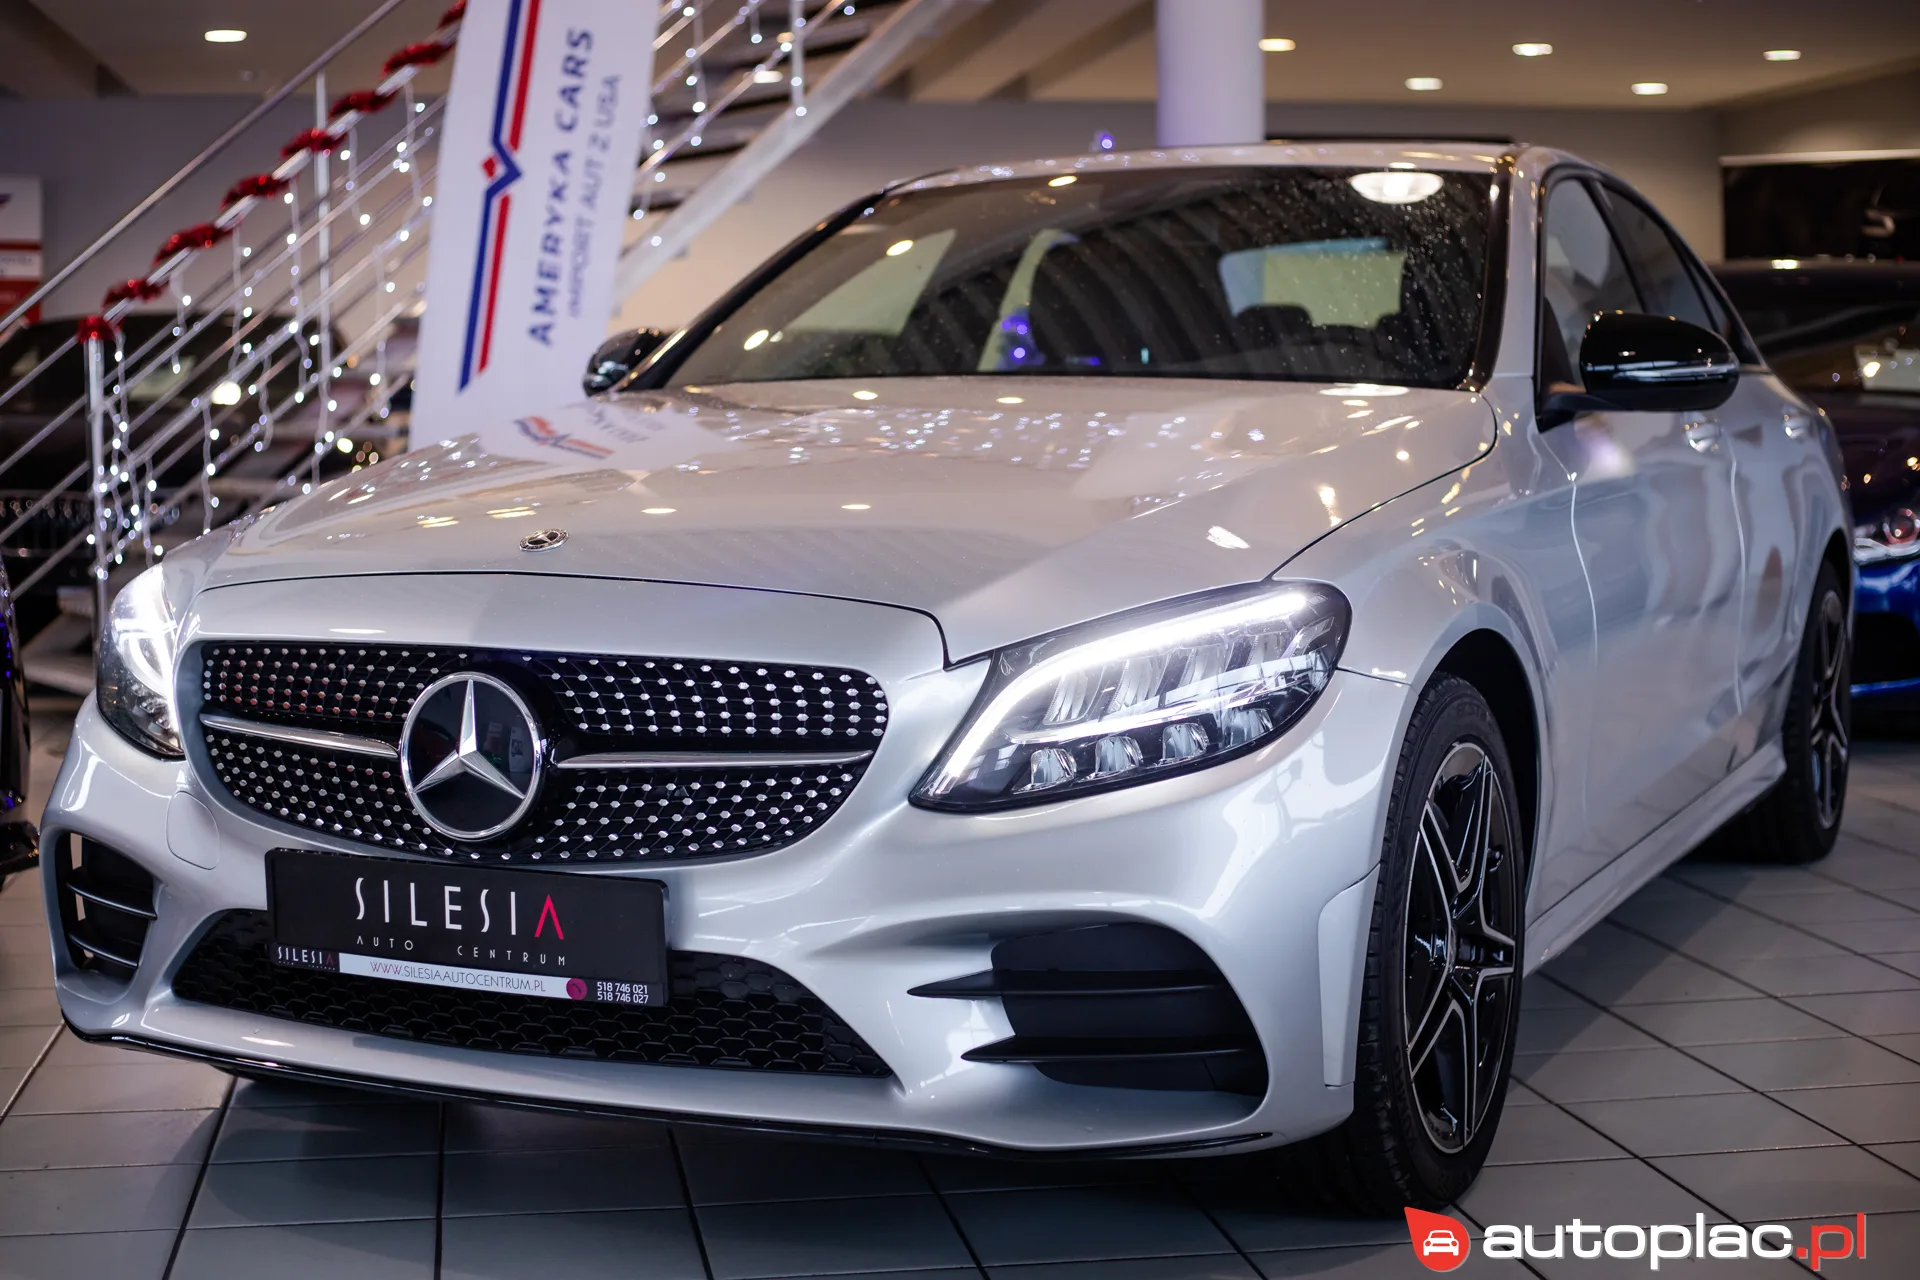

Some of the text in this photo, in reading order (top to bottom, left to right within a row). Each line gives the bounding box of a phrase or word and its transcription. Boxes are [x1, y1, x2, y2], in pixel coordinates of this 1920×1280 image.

[528, 27, 593, 347] AMERYKA CARS
[355, 877, 565, 940] SILESIA
[278, 946, 335, 965] SILESIA
[356, 935, 566, 967] AUTO CENTRUM
[370, 961, 546, 993] WWW.SILESIAAUTOCENTRUM.PL
[597, 981, 648, 994] 518 746 021
[597, 992, 649, 1004] 518 746 027
